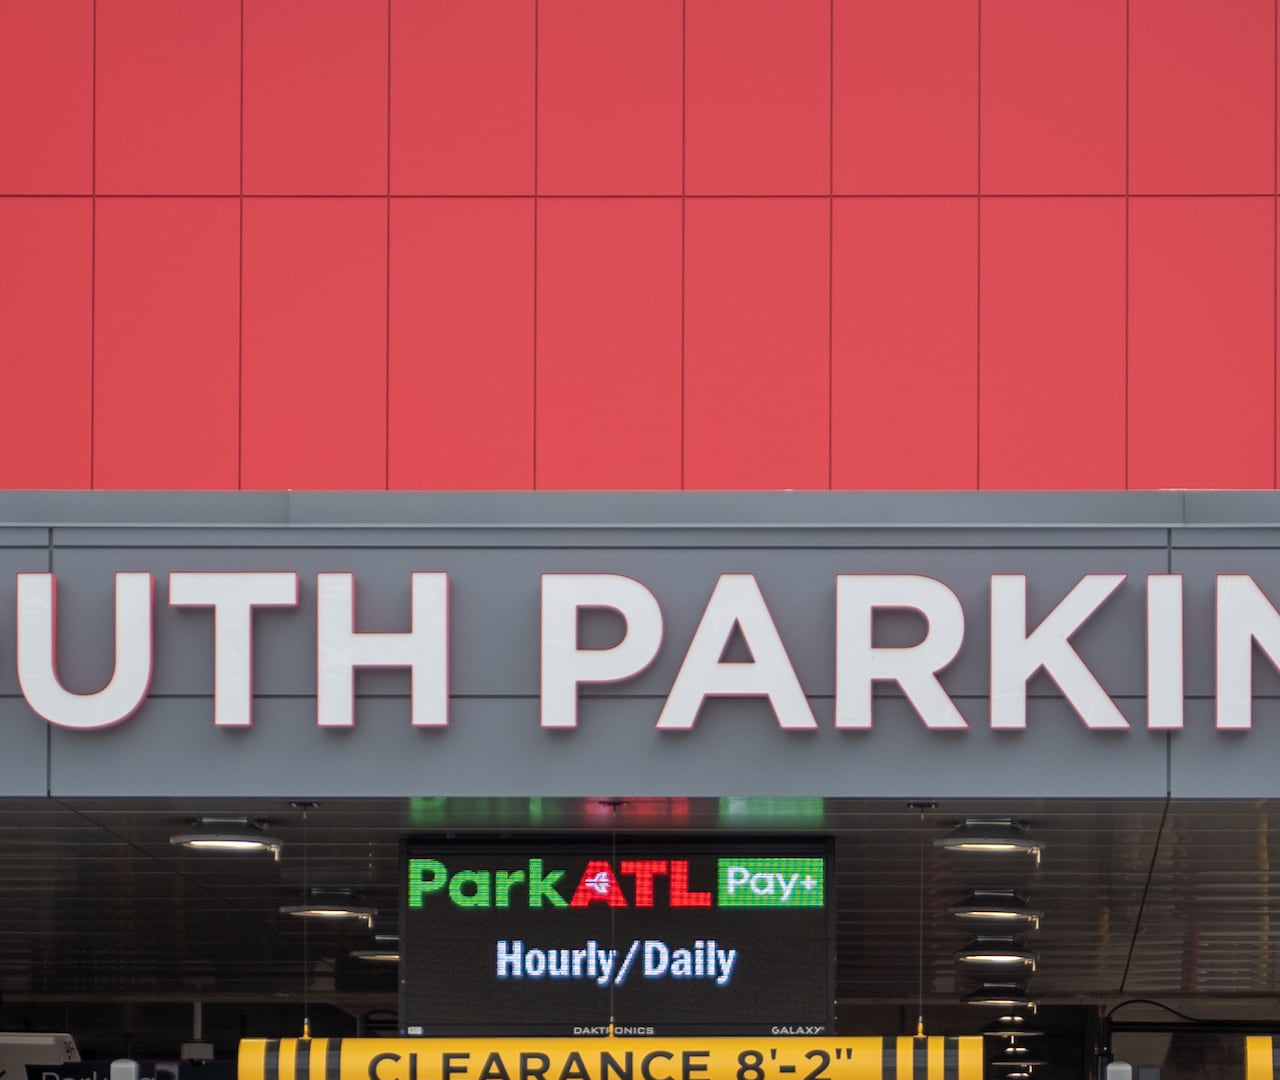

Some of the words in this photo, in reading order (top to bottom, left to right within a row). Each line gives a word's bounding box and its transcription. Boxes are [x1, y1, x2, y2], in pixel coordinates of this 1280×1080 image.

[408, 858, 712, 907] ParkATL
[726, 867, 817, 902] Pay+
[496, 940, 738, 986] Hourly/Daily
[573, 1025, 655, 1035] DAKTRONICS
